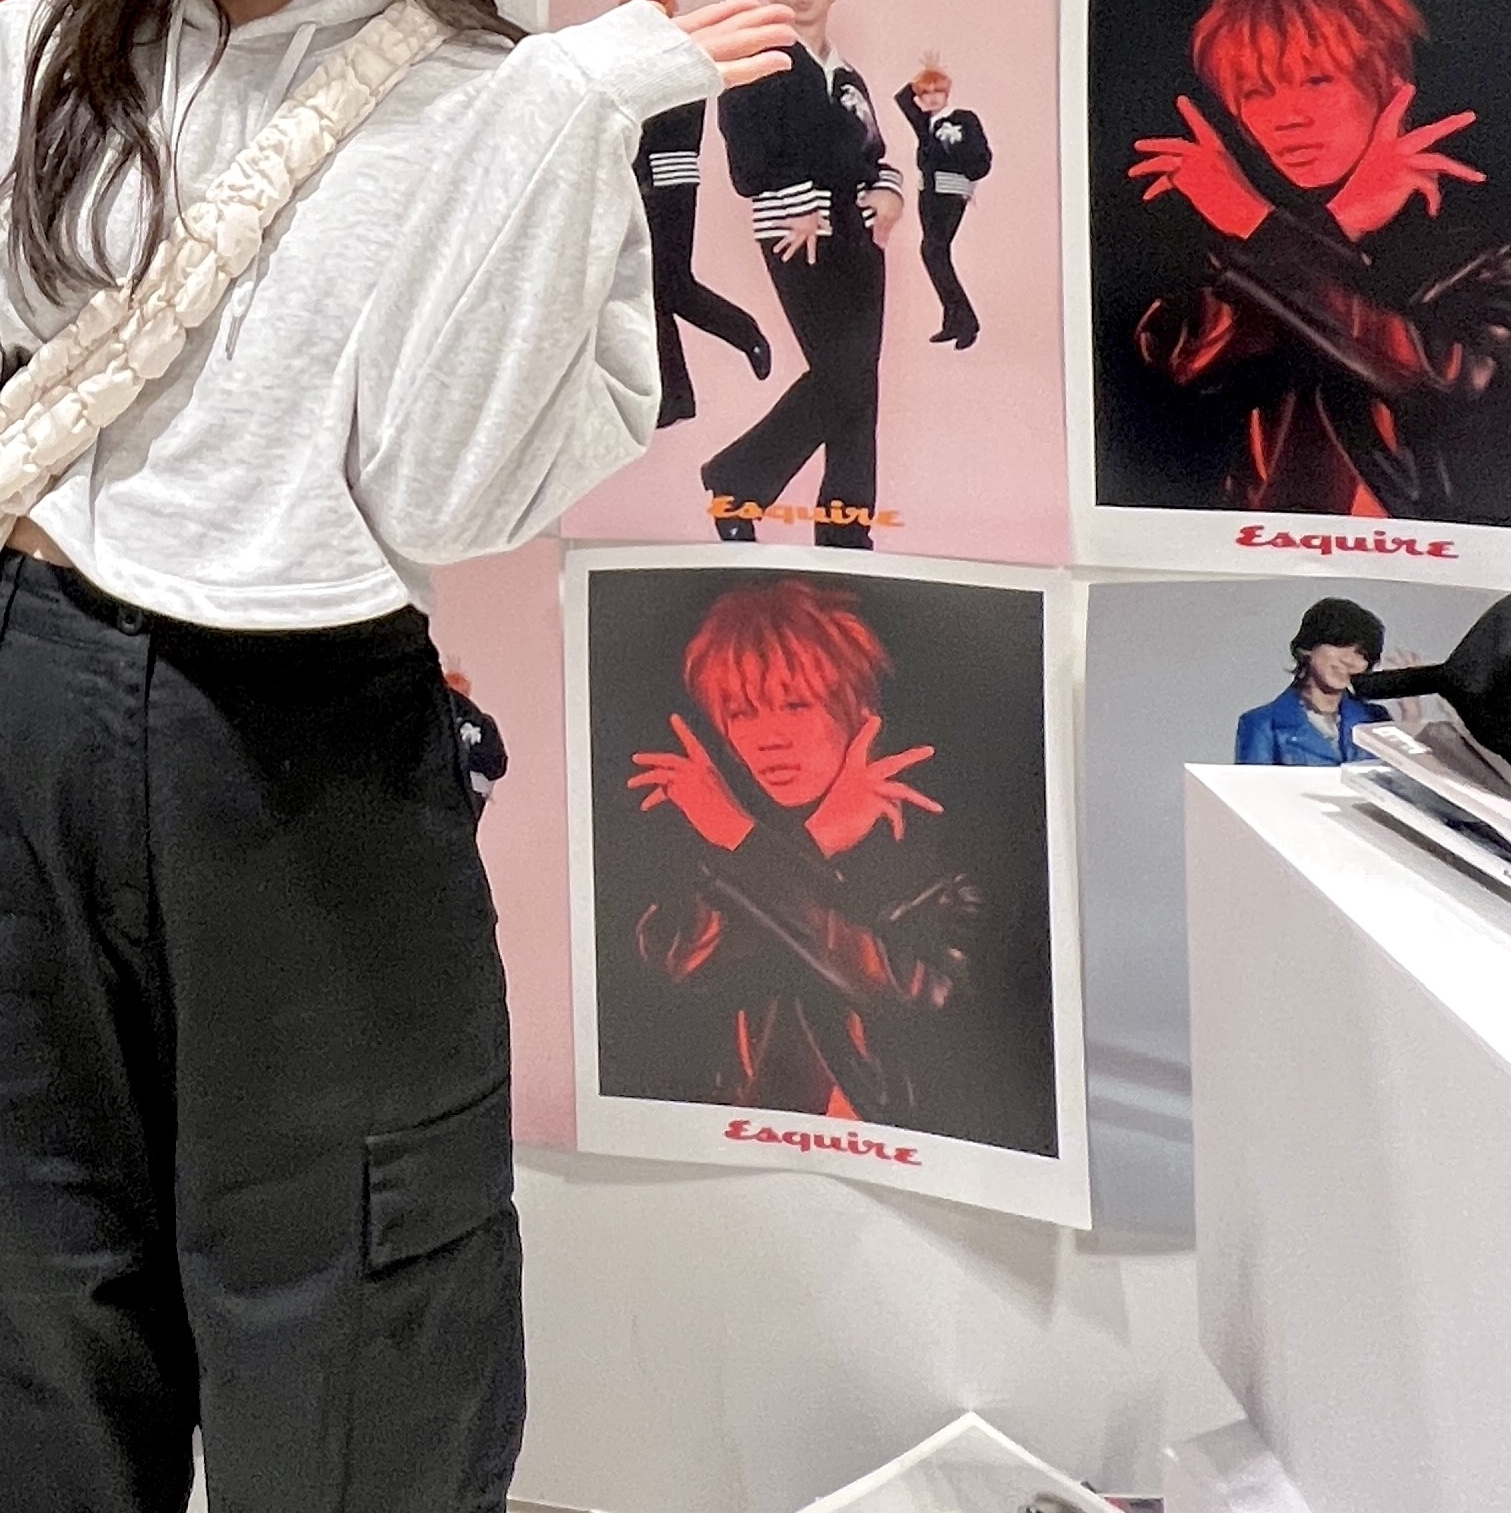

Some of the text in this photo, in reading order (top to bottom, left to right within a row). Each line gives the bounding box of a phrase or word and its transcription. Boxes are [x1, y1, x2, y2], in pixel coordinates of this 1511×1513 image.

[706, 494, 906, 528] Esquire
[1235, 525, 1458, 559] Esquire
[724, 1119, 923, 1165] Esquire
